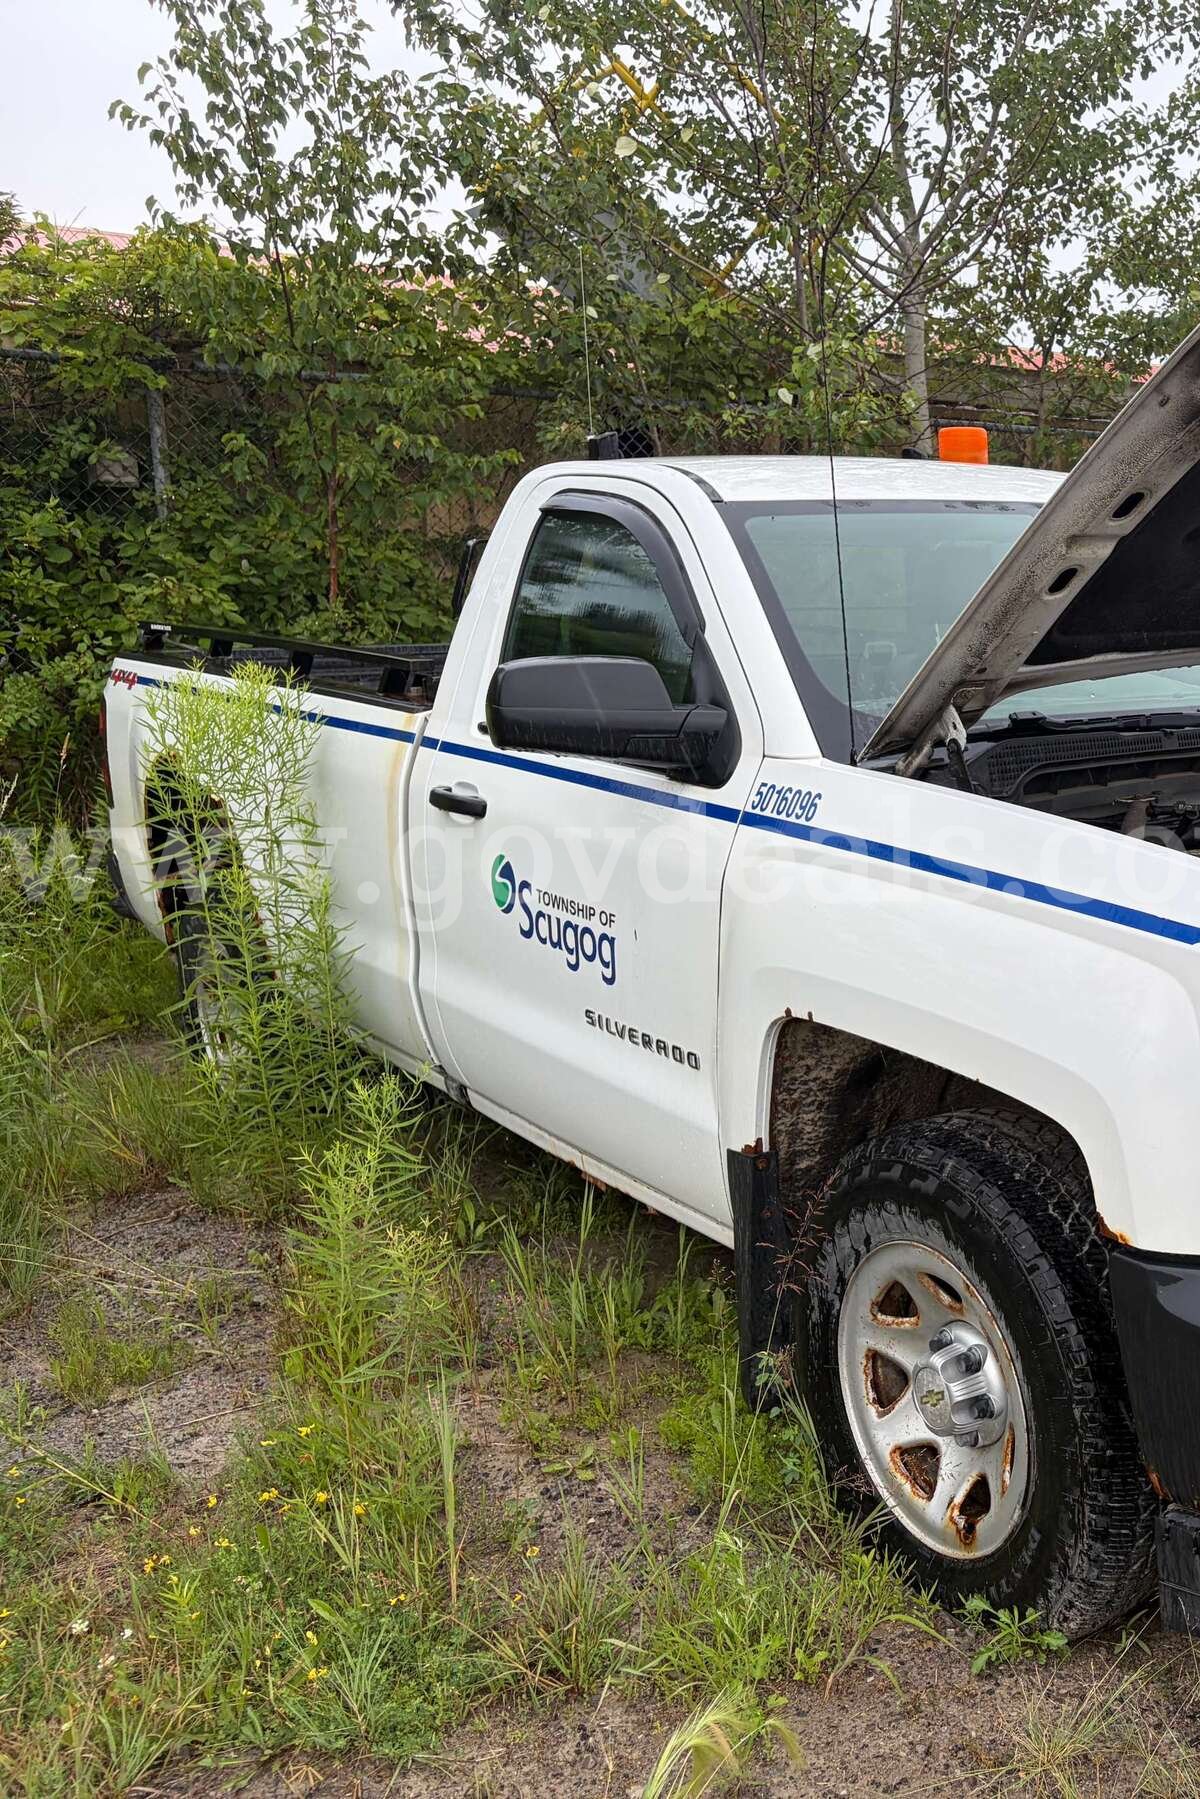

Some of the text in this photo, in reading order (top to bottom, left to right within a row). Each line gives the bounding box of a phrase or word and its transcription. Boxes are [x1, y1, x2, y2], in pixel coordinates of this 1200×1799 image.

[751, 781, 822, 822] 5016096
[518, 879, 617, 986] Scugog
[536, 887, 617, 928] TOWNSHIP OF
[584, 1008, 701, 1071] SILVERADO
